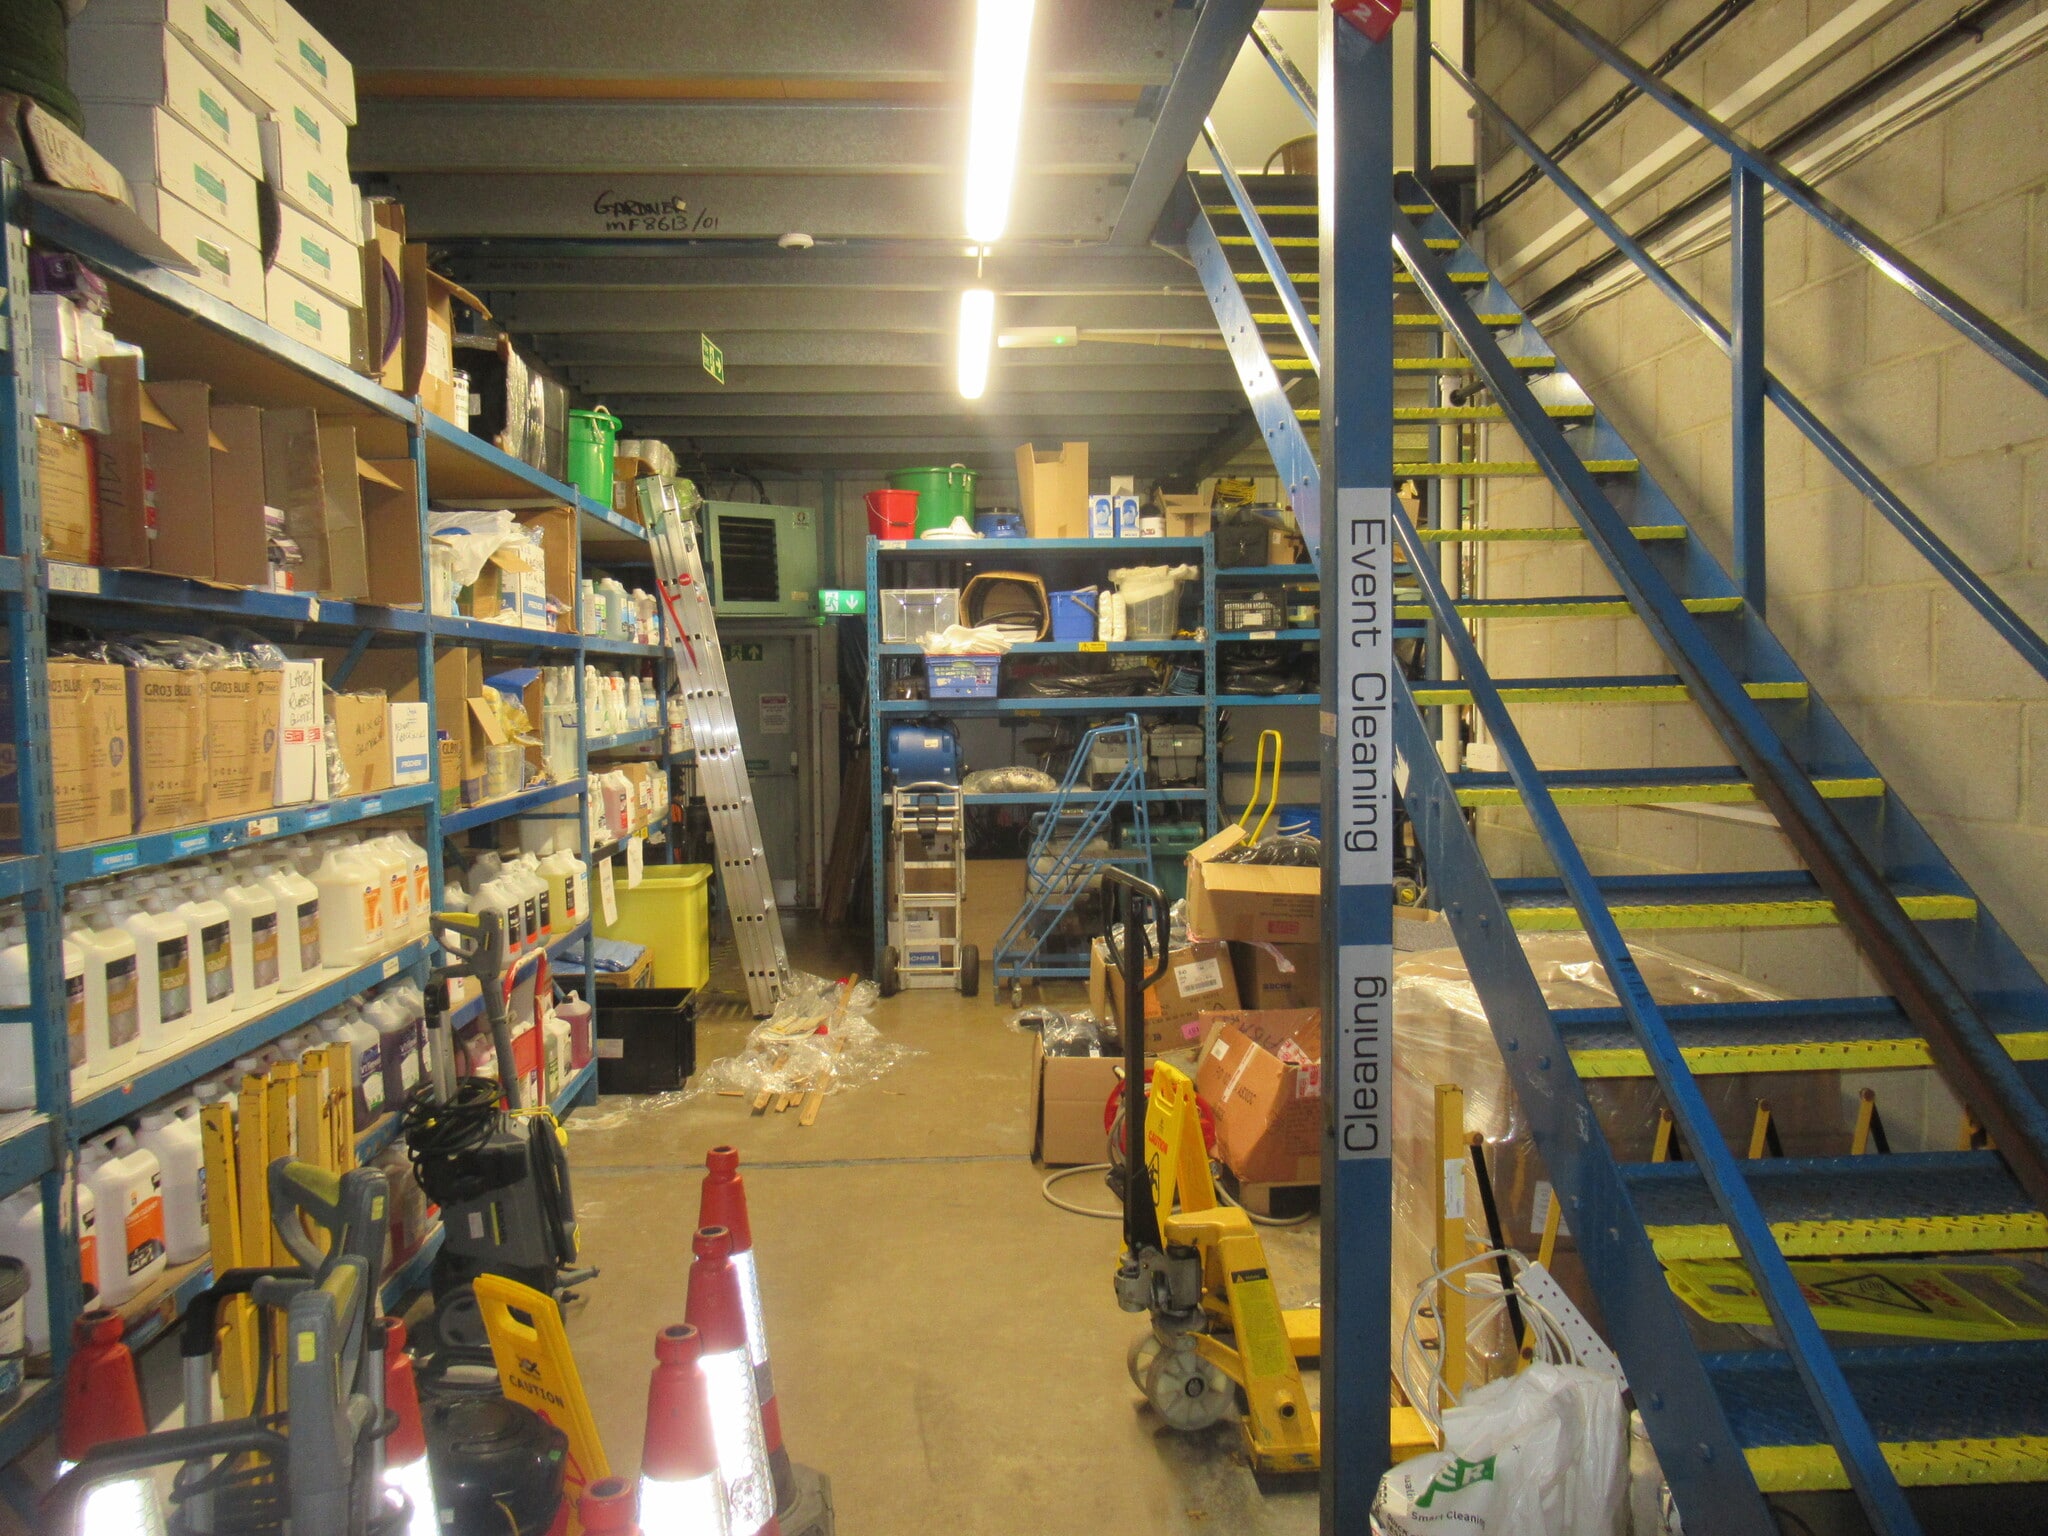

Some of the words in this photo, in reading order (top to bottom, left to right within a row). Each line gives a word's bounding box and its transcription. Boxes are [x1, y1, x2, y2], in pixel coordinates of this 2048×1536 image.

[1351, 519, 1386, 647] Event
[1344, 672, 1387, 852] Cleaning
[1344, 976, 1387, 1151] Cleaning
[508, 1374, 565, 1409] CAUTION
